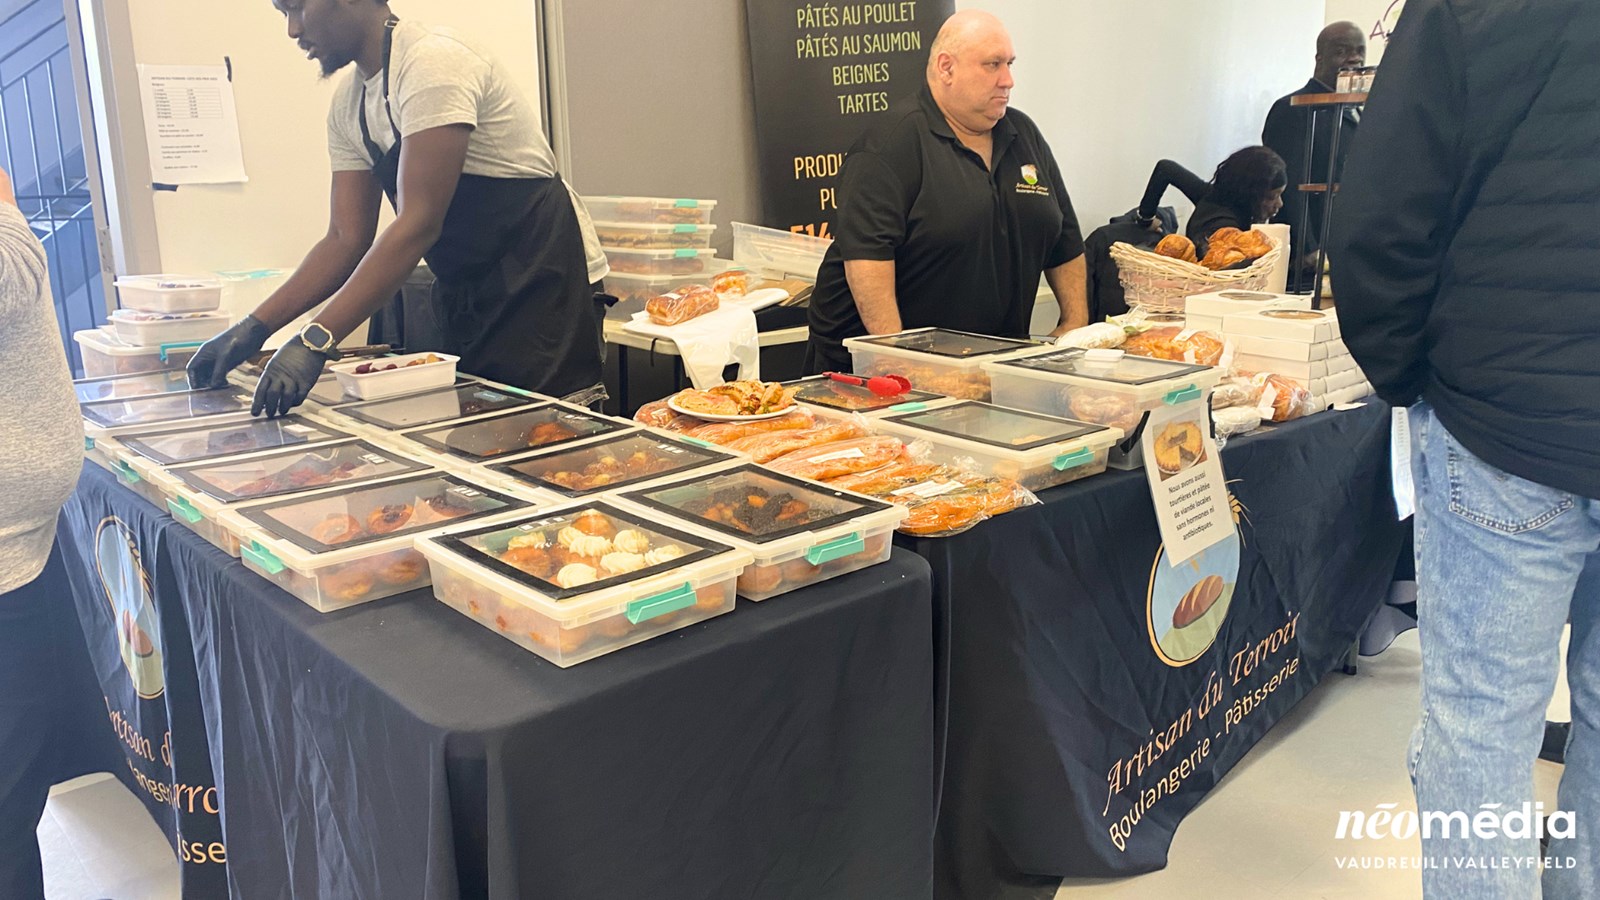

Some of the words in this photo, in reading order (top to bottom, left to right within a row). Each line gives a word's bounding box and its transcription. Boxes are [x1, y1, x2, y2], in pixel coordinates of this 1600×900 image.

[797, 2, 839, 28] PÂTÉS
[842, 6, 861, 25] AU
[864, 1, 916, 24] POULET
[796, 32, 838, 58] PÂTÉS
[842, 36, 860, 55] AU
[863, 31, 921, 53] SAUMON
[832, 62, 890, 86] BEIGNES
[837, 92, 889, 114] TARTES
[1168, 484, 1181, 493] Nous
[1180, 477, 1194, 488] avons
[1194, 470, 1206, 481] aussi
[1169, 492, 1191, 507] tourtières
[1180, 503, 1195, 515] viande
[1195, 495, 1212, 507] locales
[1176, 521, 1187, 531] sans
[1186, 510, 1209, 525] hormones
[1102, 706, 1193, 817] Artisan
[1198, 670, 1224, 720] du
[1229, 610, 1300, 687] Terroir
[1109, 737, 1211, 852] Boulangerie
[1225, 657, 1299, 735] Pâtisserie
